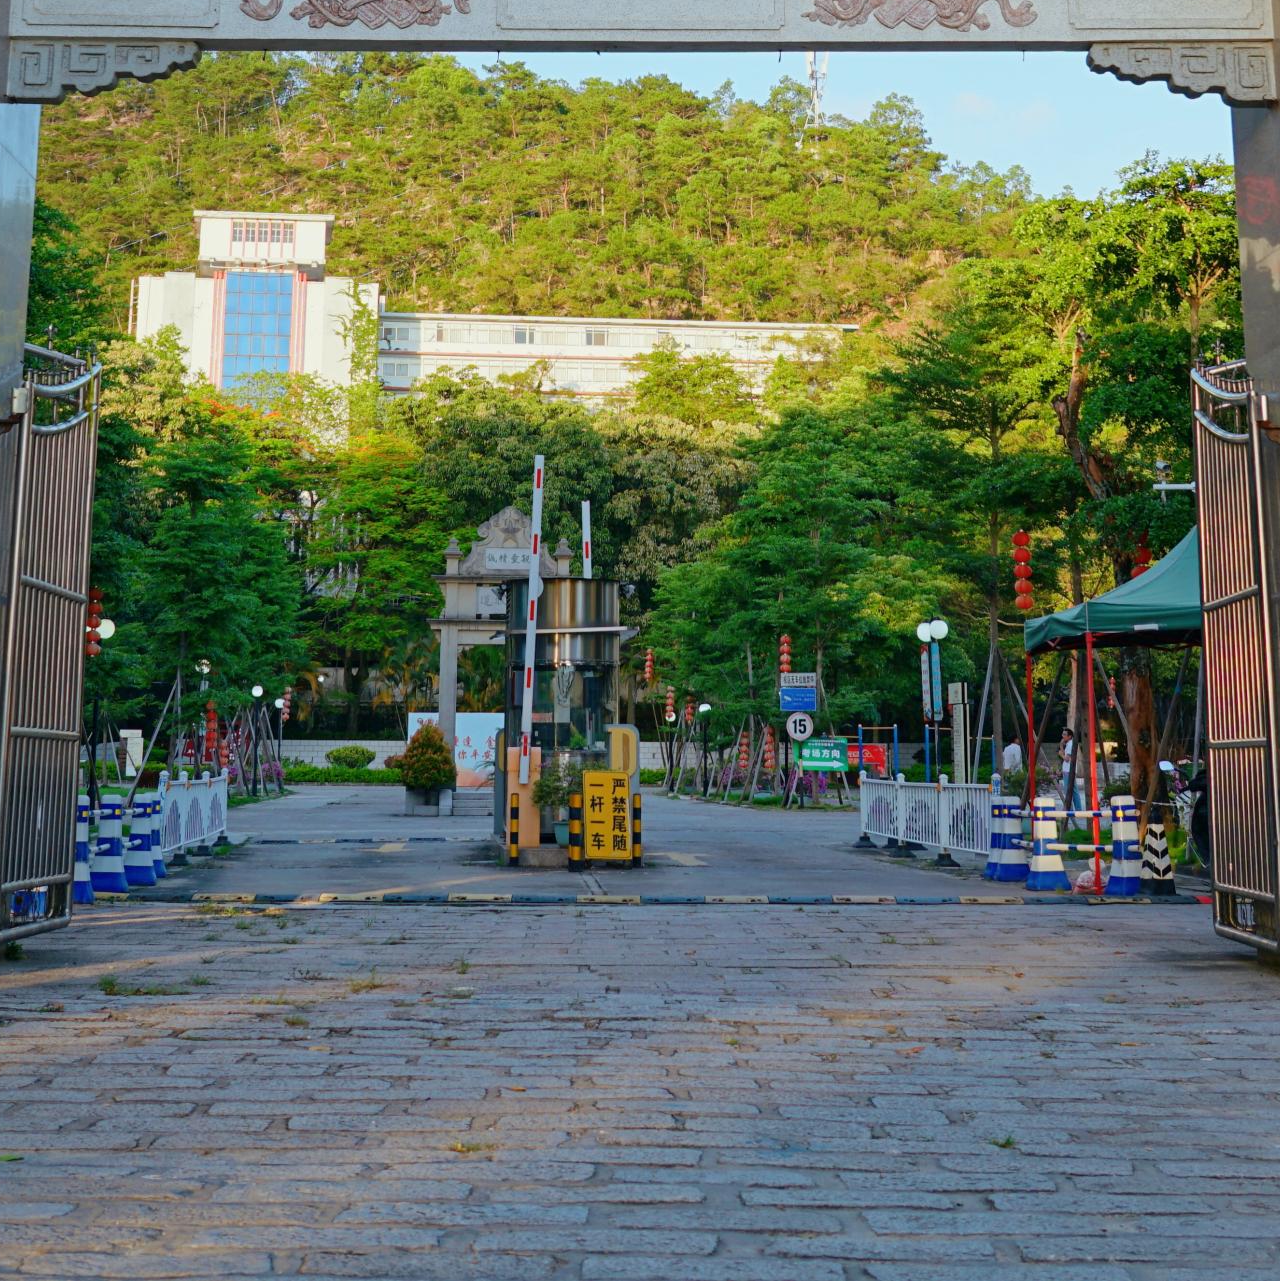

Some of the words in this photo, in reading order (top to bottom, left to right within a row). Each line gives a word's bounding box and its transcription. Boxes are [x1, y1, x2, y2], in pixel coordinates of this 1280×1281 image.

[792, 718, 807, 734] 15
[801, 748, 841, 759] 考场方向
[589, 782, 606, 851] 一杆一车
[611, 778, 628, 851] 严禁尾随
